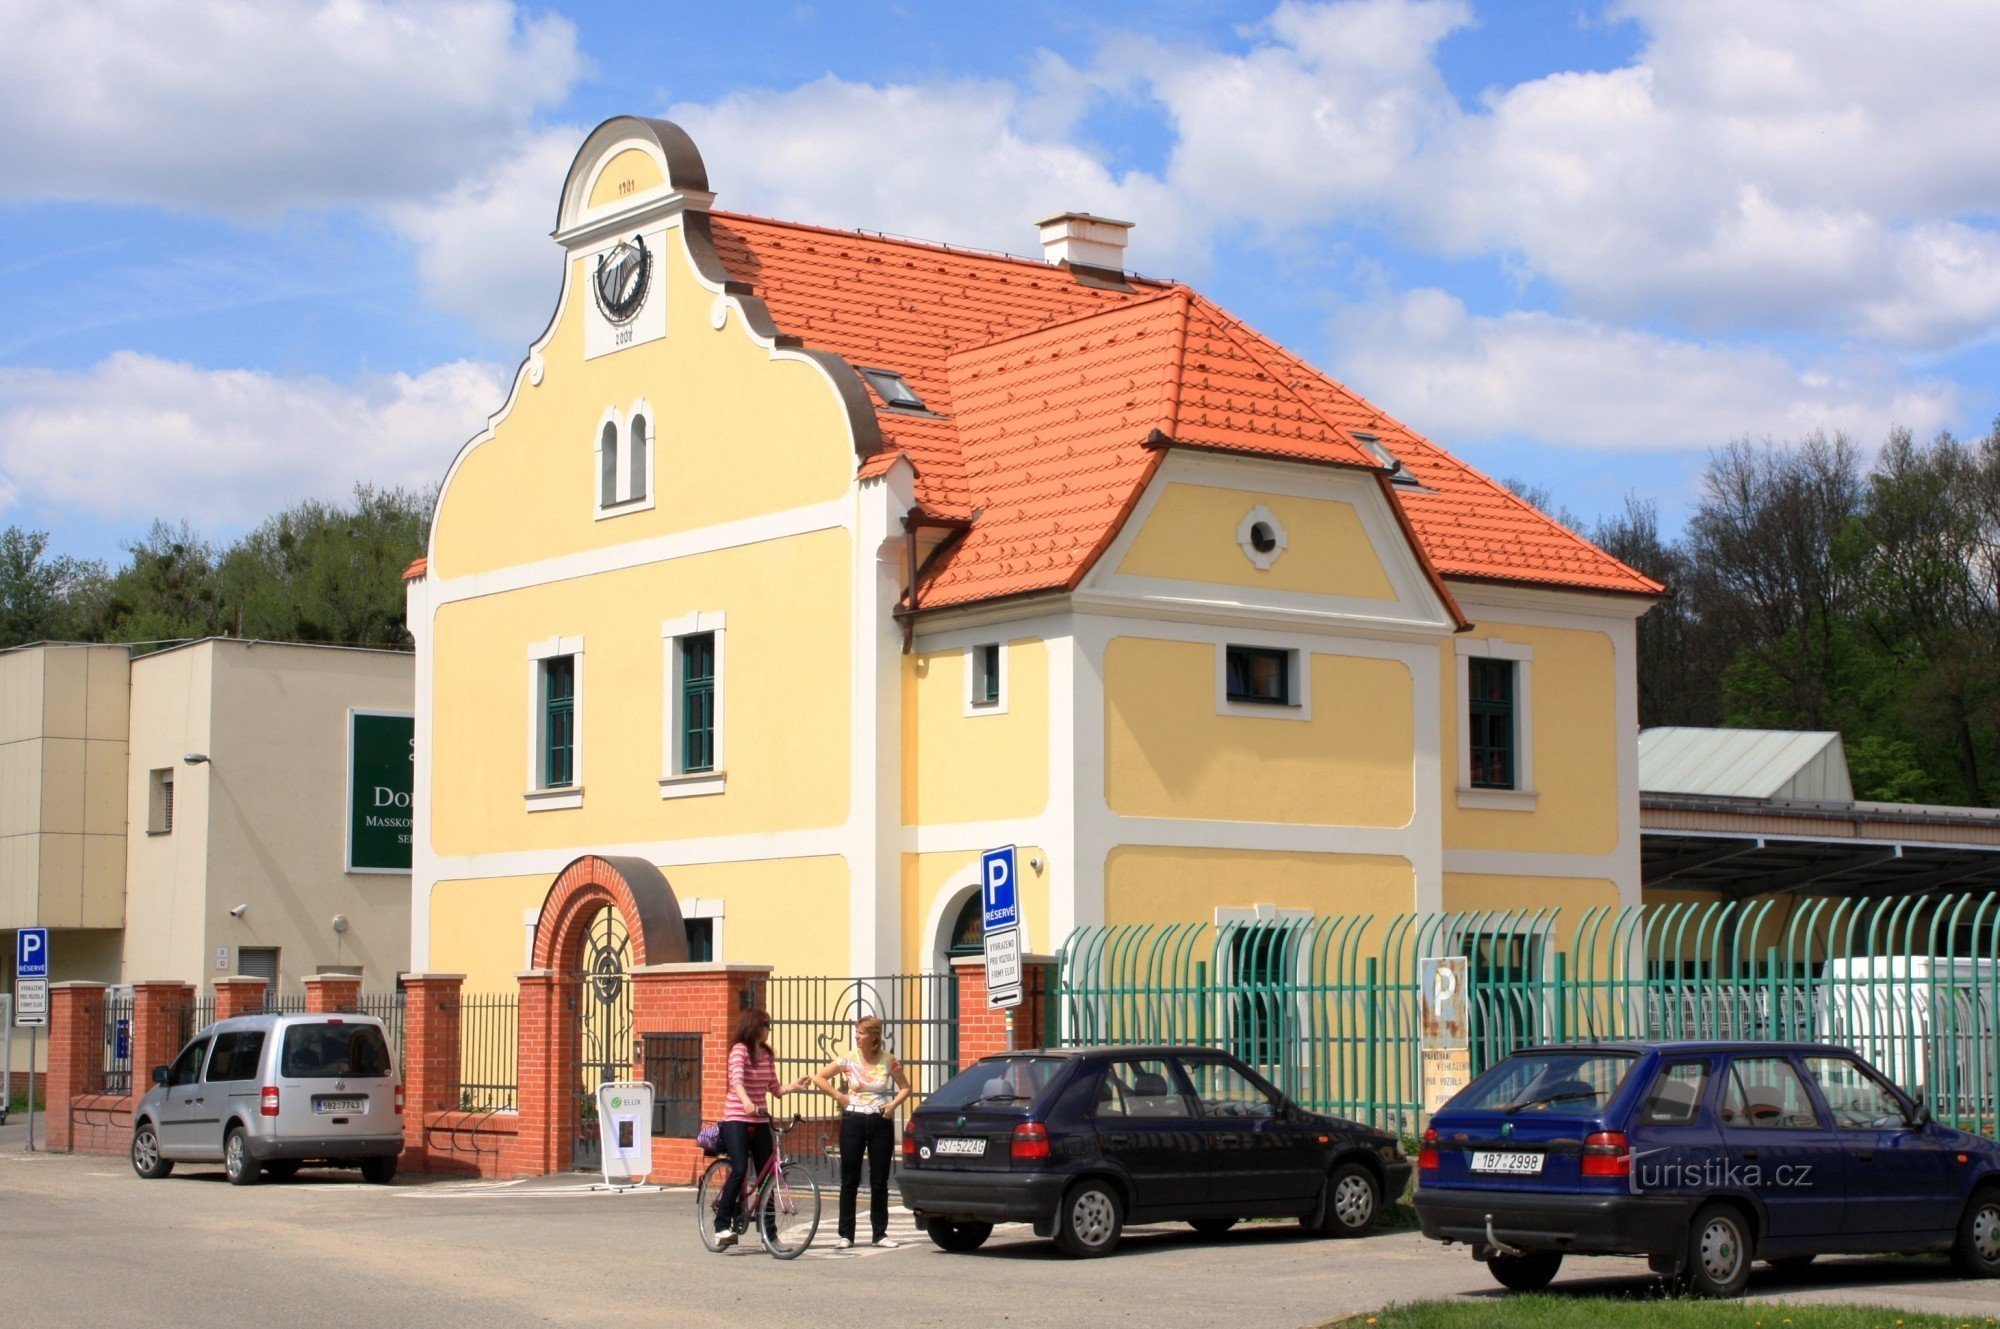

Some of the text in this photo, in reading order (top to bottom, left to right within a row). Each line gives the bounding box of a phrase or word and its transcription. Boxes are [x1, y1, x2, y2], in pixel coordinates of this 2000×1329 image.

[988, 858, 1008, 905] P
[985, 904, 1015, 922] RÉSERVÉ
[23, 934, 41, 962] P
[989, 940, 1015, 952] VYHRAZENO
[990, 953, 1016, 965] PRO VOZIDLA
[19, 964, 45, 972] RÉSERVÉ
[991, 966, 1015, 979] FIRMY ELUX
[1434, 967, 1456, 1017] P
[1509, 1155, 1539, 1170] 2998
